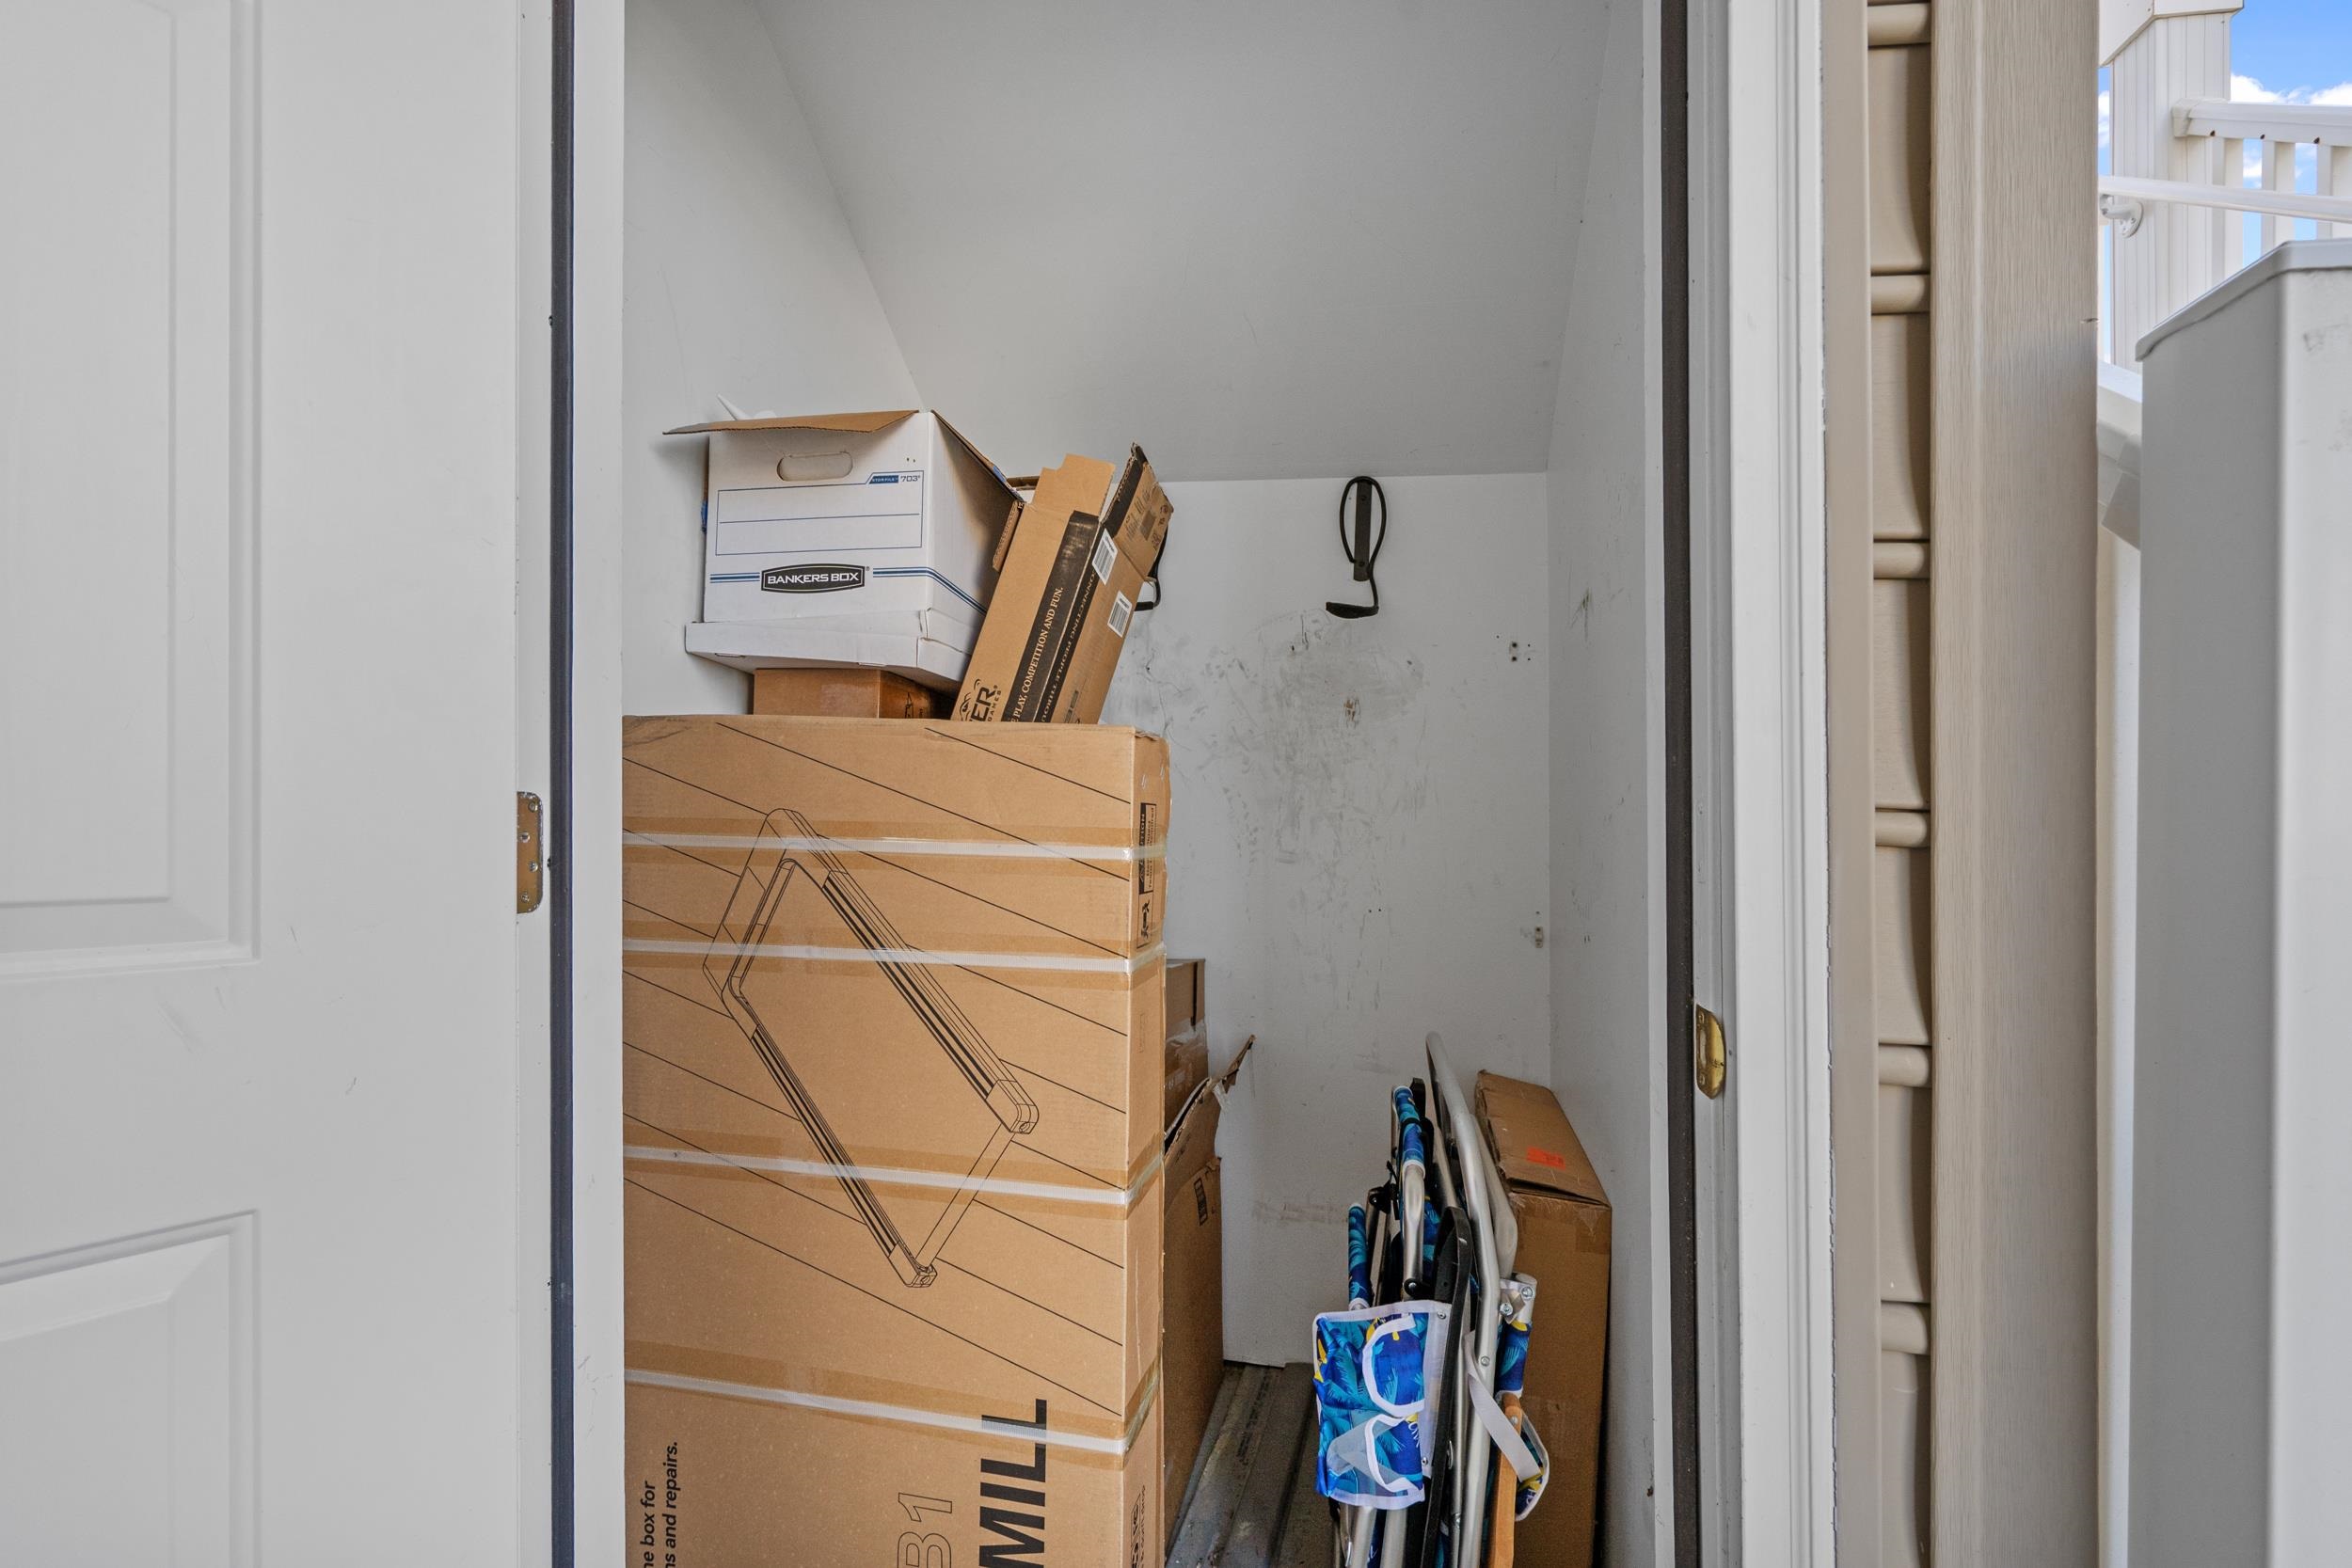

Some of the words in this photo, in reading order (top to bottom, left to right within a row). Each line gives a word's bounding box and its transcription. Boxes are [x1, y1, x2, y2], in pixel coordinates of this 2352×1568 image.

[767, 573, 829, 584] BANKERS
[831, 572, 860, 582] BOX
[1012, 694, 1027, 718] PLAY,
[1022, 629, 1049, 693] COMPETITION
[1043, 609, 1056, 629] AND
[1050, 587, 1064, 608] FUN.
[969, 687, 996, 721] ER
[662, 1441, 681, 1509] repairs.
[978, 1398, 1047, 1568] MILL
[641, 1480, 656, 1508] for
[640, 1513, 655, 1546] box
[661, 1513, 677, 1548] and
